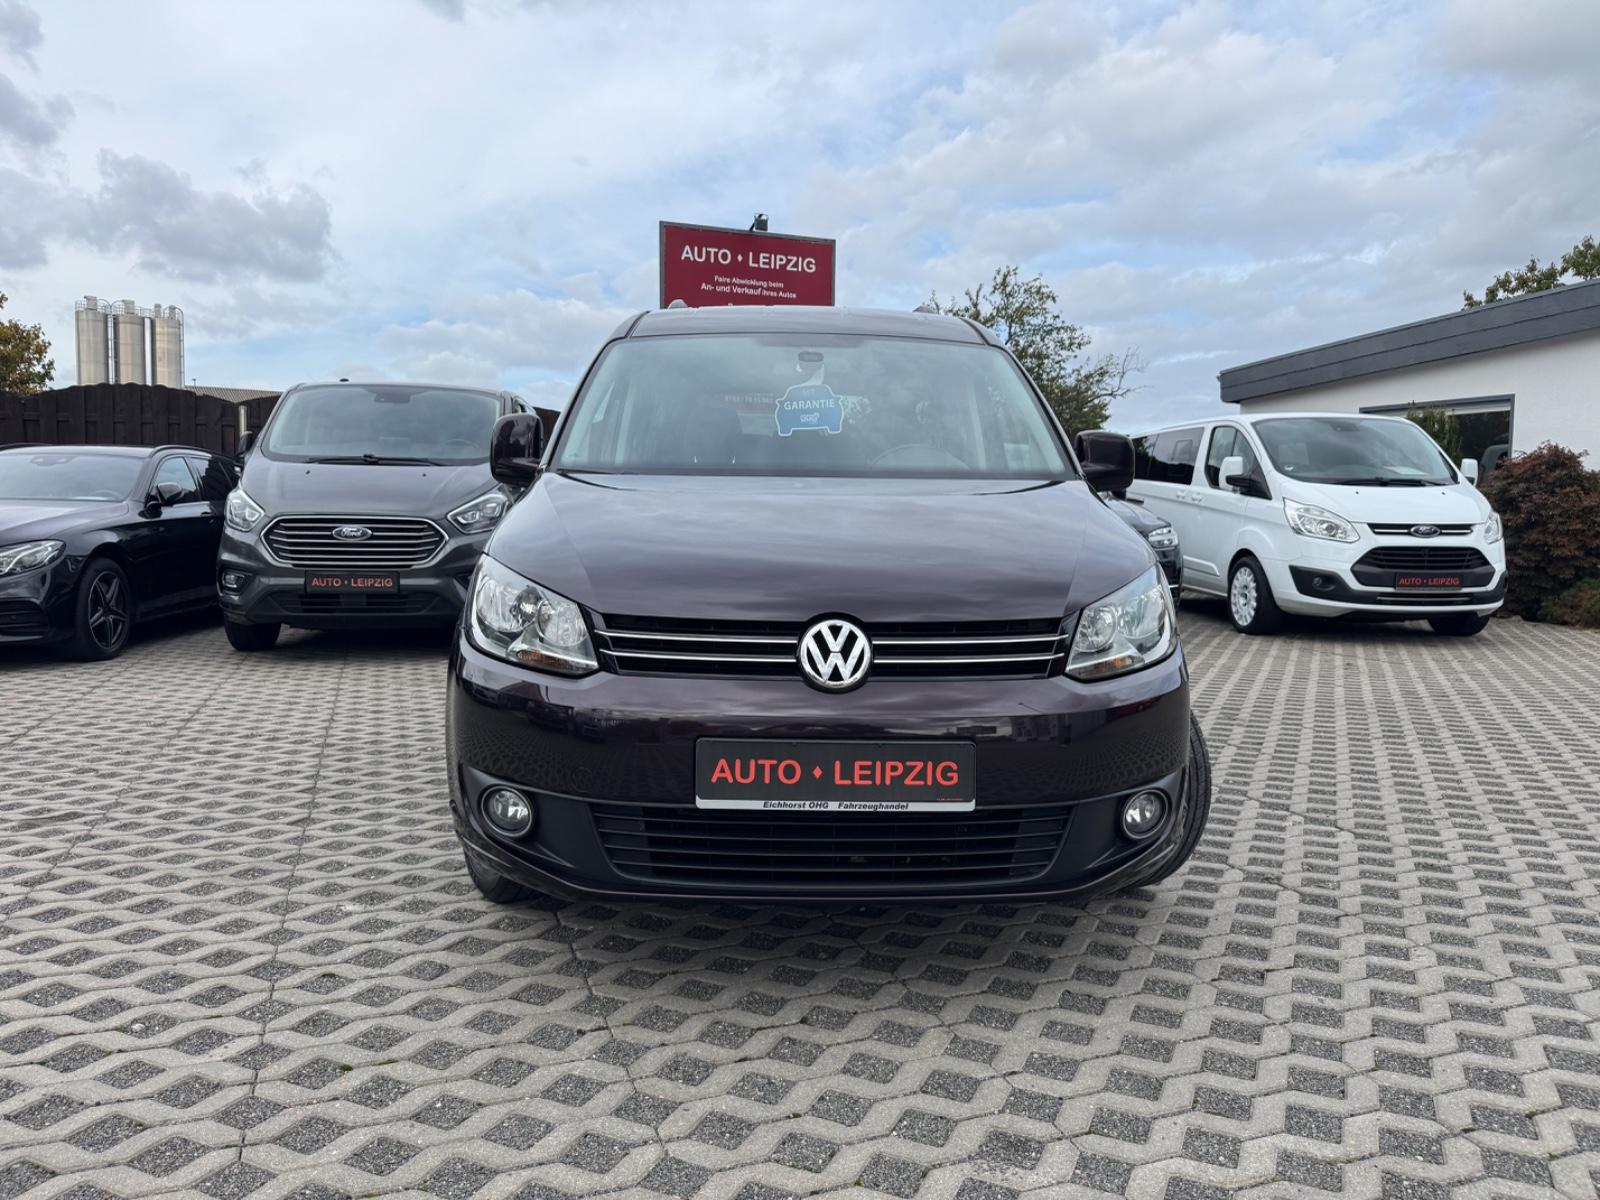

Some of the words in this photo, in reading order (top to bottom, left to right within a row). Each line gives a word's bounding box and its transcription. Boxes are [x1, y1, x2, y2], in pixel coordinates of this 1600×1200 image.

[681, 245, 731, 264] AUTO
[749, 252, 816, 272] LEIPZIG
[714, 275, 730, 283] Faire
[732, 277, 768, 288] Abwicklung
[701, 282, 714, 290] An-
[732, 286, 761, 295] Verkauf
[784, 400, 835, 410] GARANTIE
[312, 578, 341, 587] AUTO
[351, 578, 393, 587] LEIPZIG
[1399, 577, 1422, 585] AUTO
[1428, 577, 1460, 586] LEIPZIG
[711, 758, 801, 784] AUTO
[834, 760, 959, 786] LEIPZIG
[763, 801, 806, 809] Eichhorst
[808, 801, 829, 809] OHG
[838, 802, 909, 811] Fahrzeughandel
